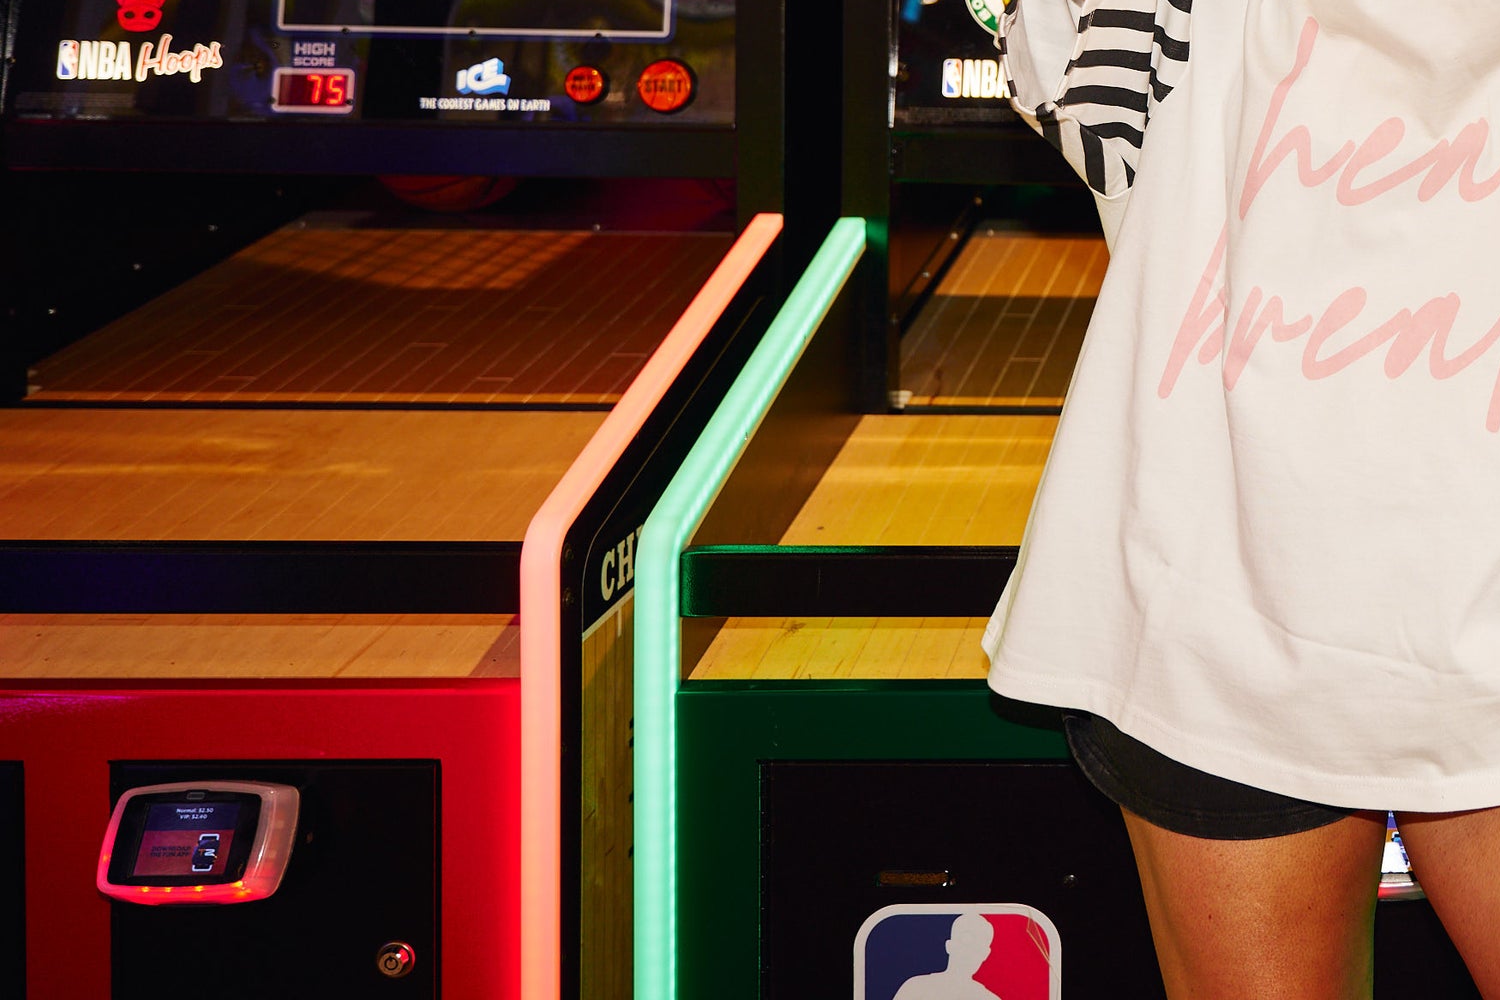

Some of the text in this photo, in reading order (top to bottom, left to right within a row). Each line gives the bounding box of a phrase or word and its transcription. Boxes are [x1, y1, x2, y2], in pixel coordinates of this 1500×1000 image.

[295, 42, 335, 55] HIGH
[78, 34, 223, 83] NBA Hoops
[294, 56, 334, 67] SCORE
[456, 57, 510, 94] ICE
[307, 75, 345, 105] 75
[645, 79, 682, 93] START
[420, 97, 550, 112] THE COOLEST GAMES ON EARTH
